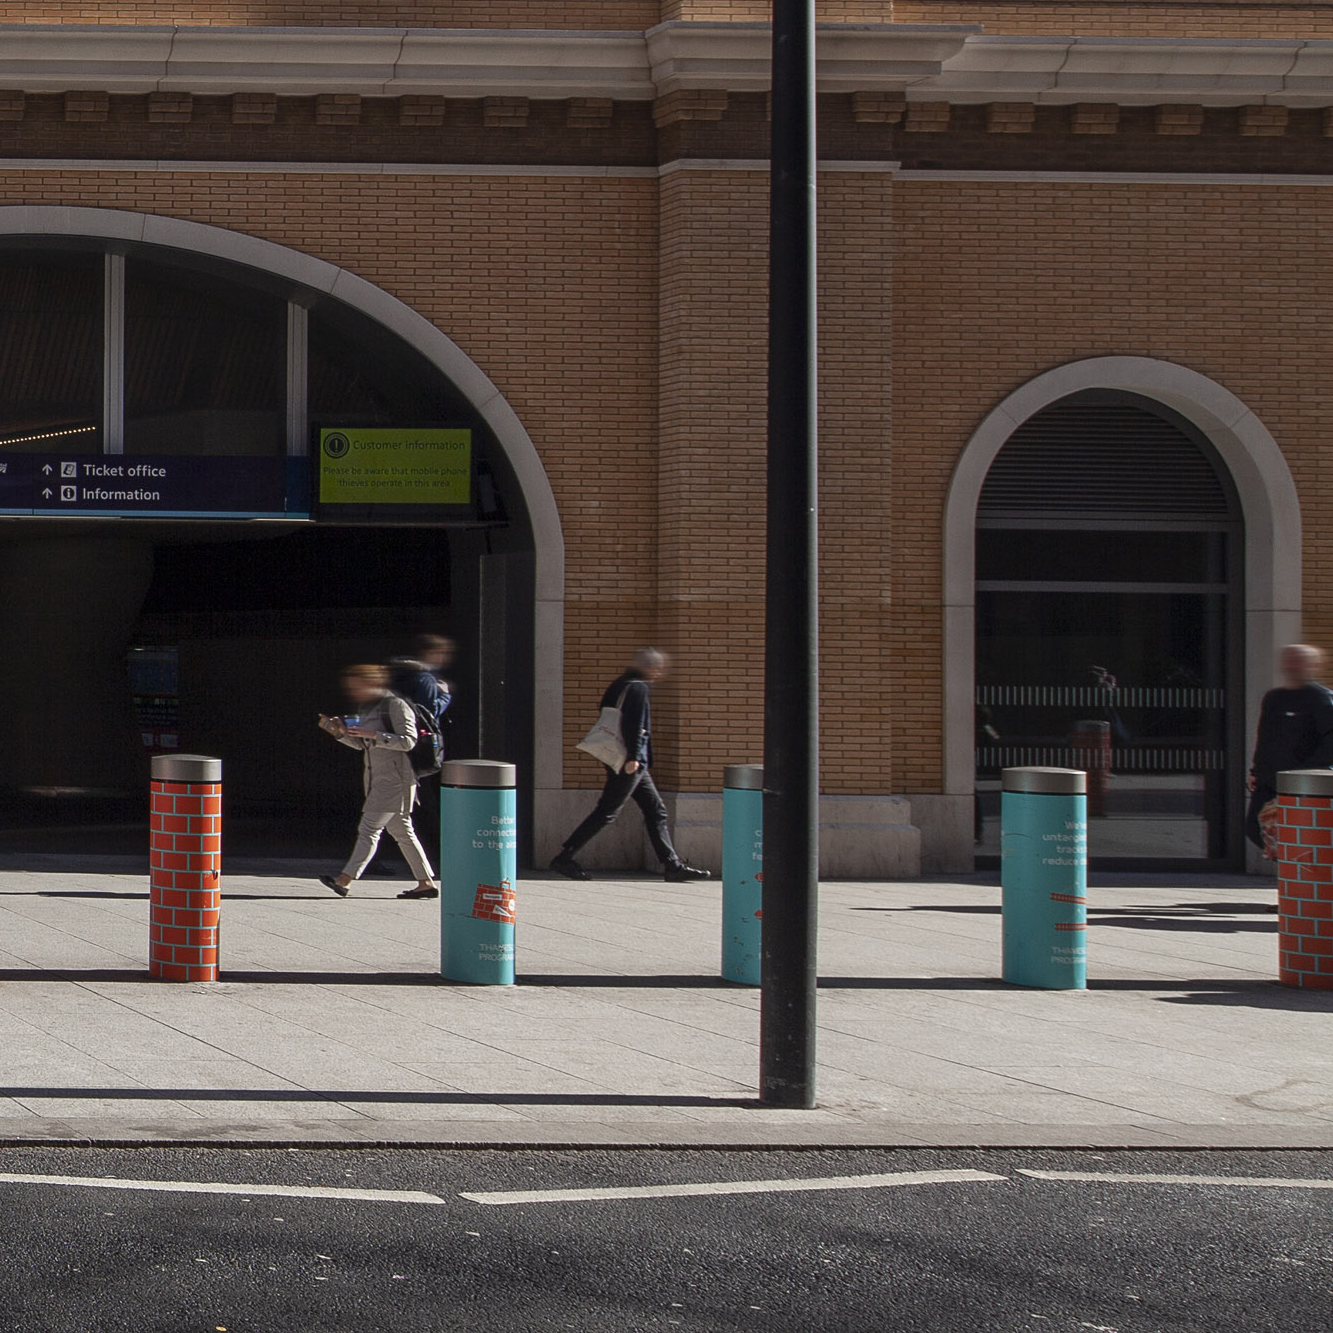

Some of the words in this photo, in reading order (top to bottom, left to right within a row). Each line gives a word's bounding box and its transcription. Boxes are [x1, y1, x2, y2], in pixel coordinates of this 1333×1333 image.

[353, 440, 402, 450] Customer
[405, 440, 465, 450] information
[83, 464, 124, 477] Ticket
[128, 465, 167, 478] office
[323, 467, 350, 475] Please
[351, 467, 362, 475] be
[391, 467, 408, 475] that
[410, 467, 439, 475] mobile
[440, 467, 468, 477] phone
[339, 479, 368, 487] thieves
[370, 479, 401, 488] operate
[404, 479, 413, 487] in
[415, 479, 430, 487] this
[83, 487, 160, 501] Information
[472, 839, 484, 849] to
[488, 839, 504, 849] the
[1042, 857, 1078, 866] reduce
